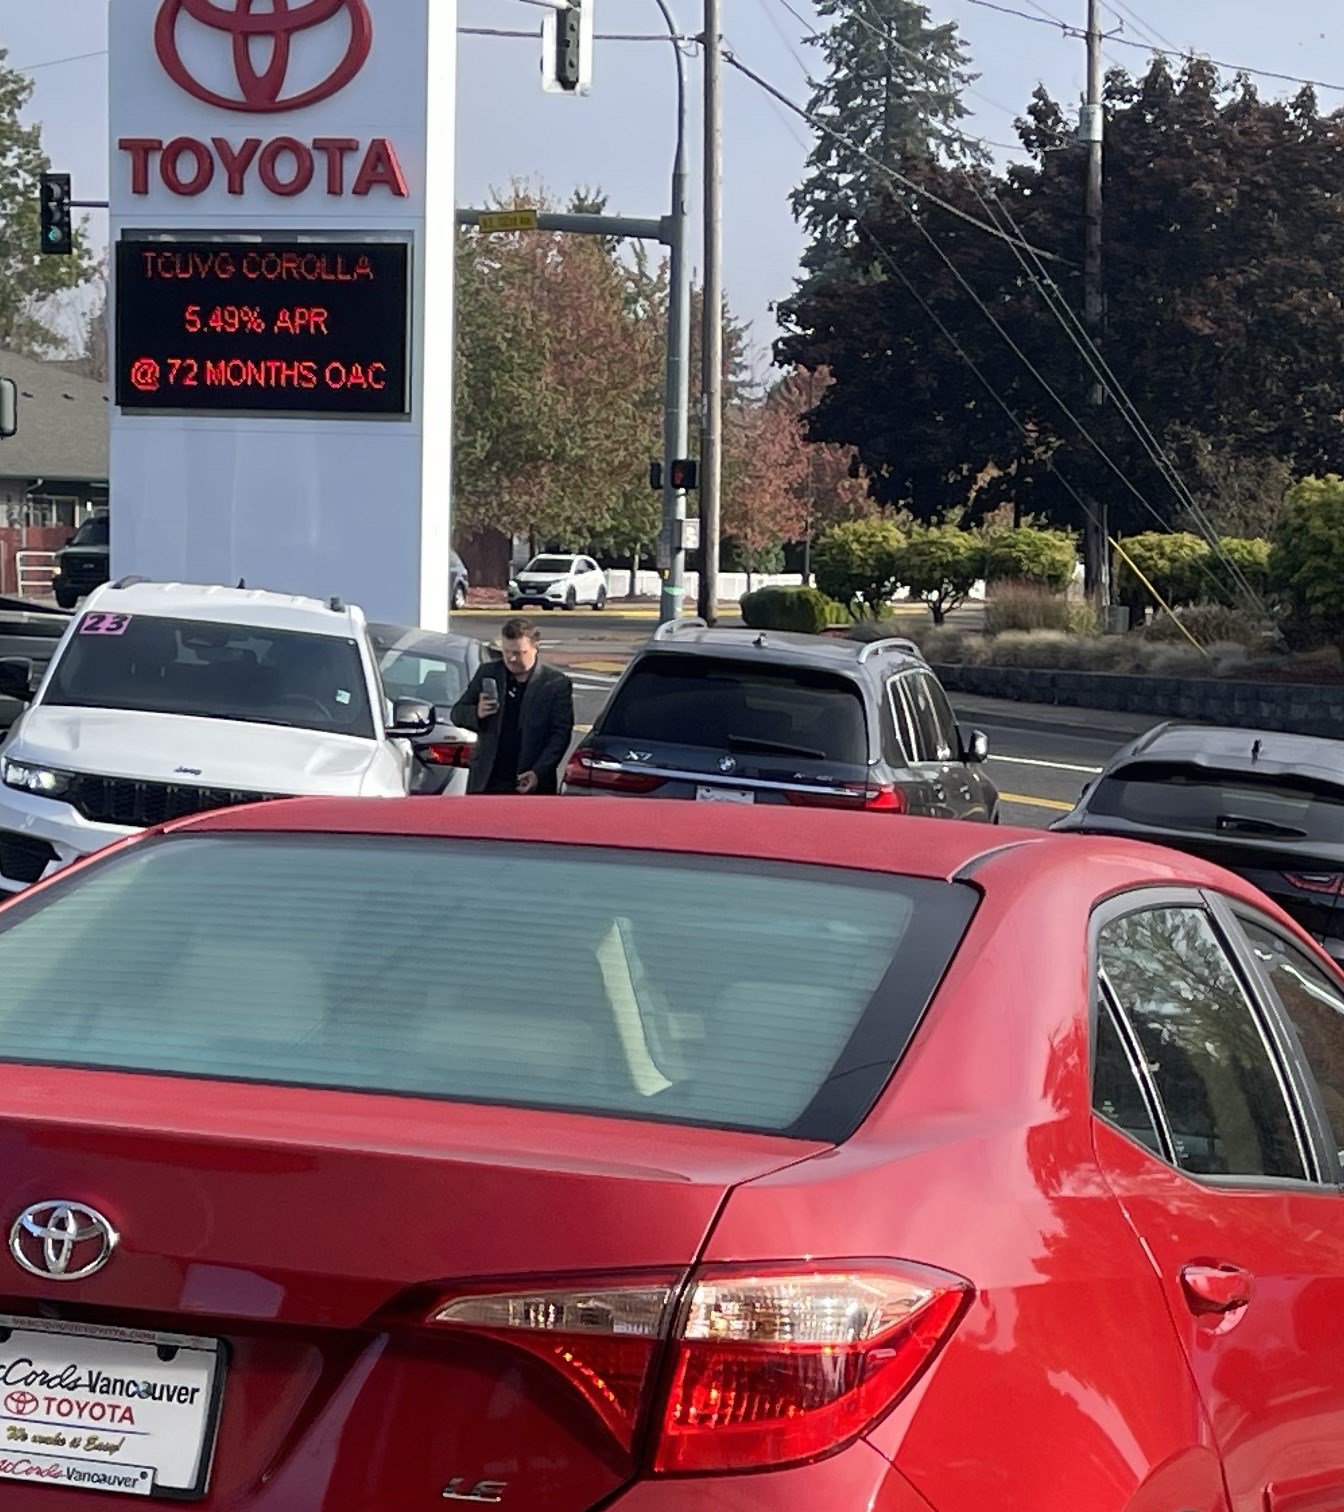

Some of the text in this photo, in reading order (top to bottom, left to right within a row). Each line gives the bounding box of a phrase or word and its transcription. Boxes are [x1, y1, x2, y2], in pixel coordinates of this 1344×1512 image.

[118, 135, 410, 198] TOYOTA
[242, 252, 375, 281] COROLLA
[184, 304, 329, 335] 5.49% APR
[130, 357, 387, 391] @ 72 MONTHS OAC
[84, 614, 129, 632] 23
[88, 1369, 201, 1405] Vancouver
[42, 1396, 136, 1425] TOYOTA
[66, 1466, 139, 1489] Vancouver
[442, 1477, 508, 1503] LE
